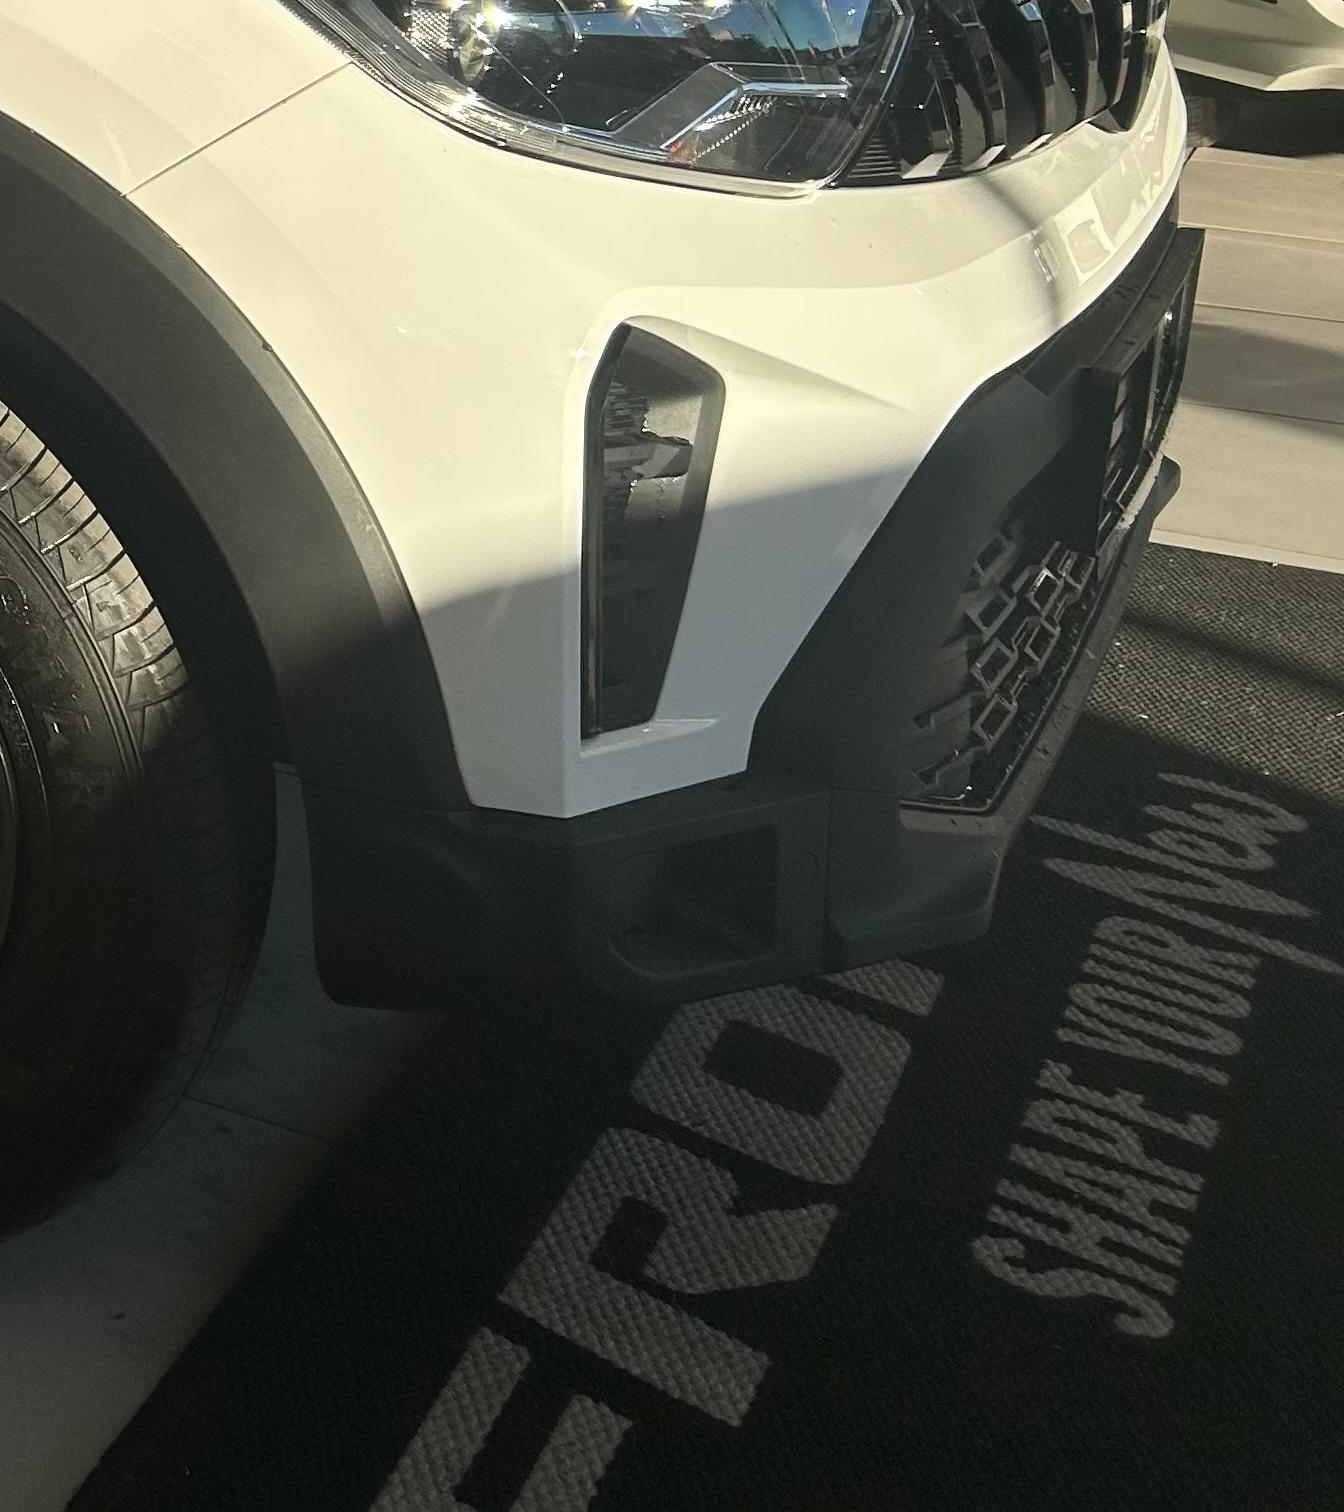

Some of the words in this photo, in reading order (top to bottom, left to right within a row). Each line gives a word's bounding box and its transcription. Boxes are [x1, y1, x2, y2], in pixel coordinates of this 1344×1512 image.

[1056, 915, 1263, 1088] YOUR
[369, 958, 946, 1512] FRO
[971, 1058, 1223, 1343] SHAPE
